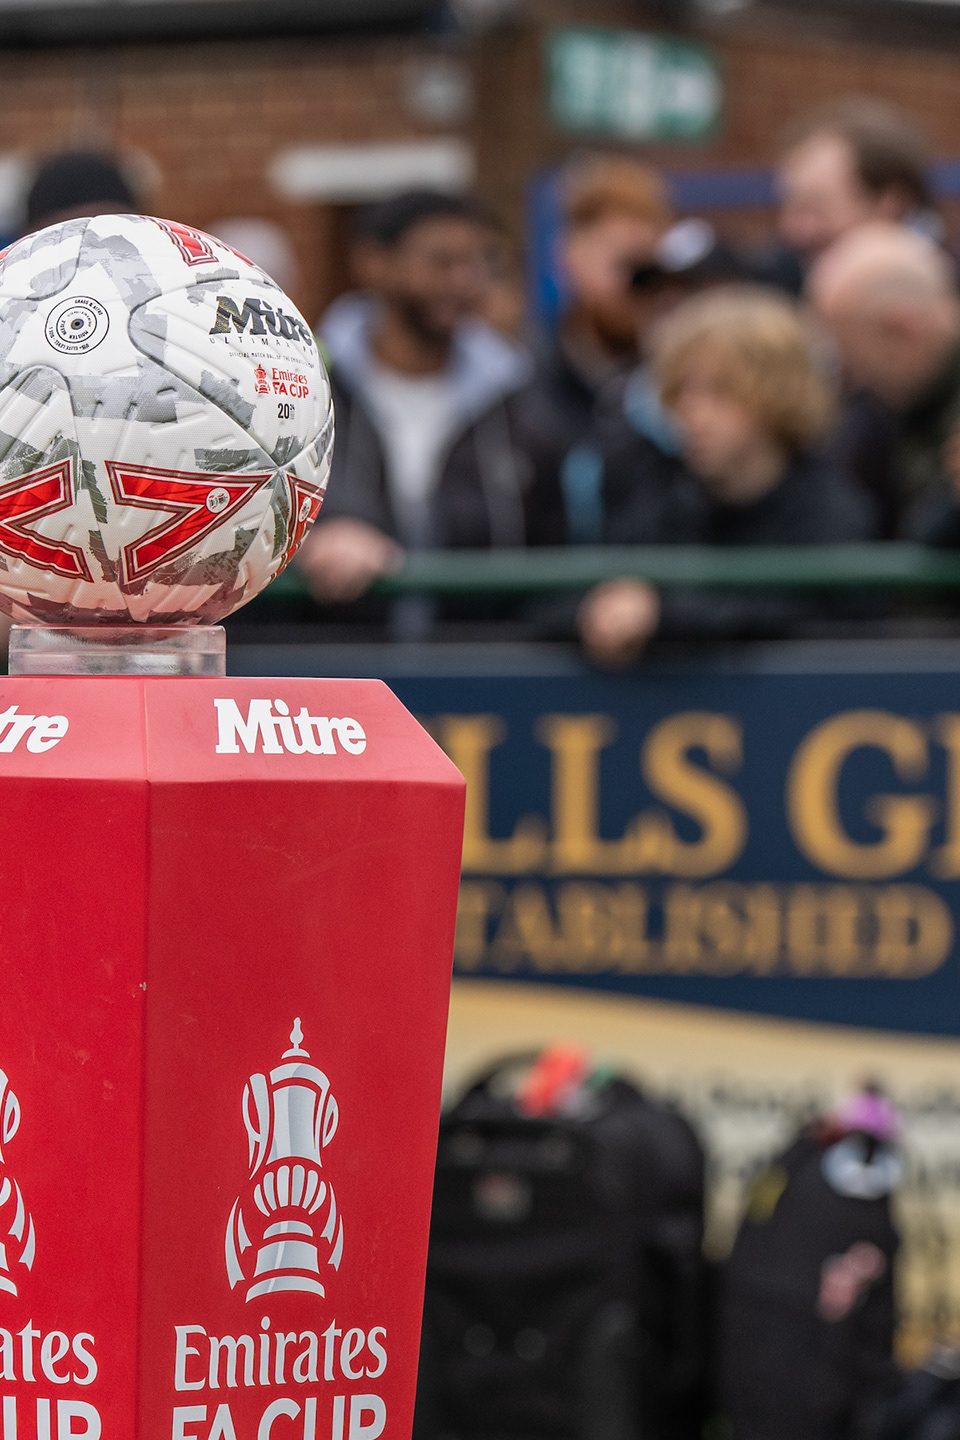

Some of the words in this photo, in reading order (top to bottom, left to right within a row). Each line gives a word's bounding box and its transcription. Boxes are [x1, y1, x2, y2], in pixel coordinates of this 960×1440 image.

[209, 296, 312, 347] Mitre
[272, 367, 308, 385] Emiraes
[272, 382, 288, 397] FA
[289, 383, 309, 399] CUP
[213, 698, 367, 756] Mitre
[428, 710, 745, 878] LLS
[452, 880, 950, 978] TABLISHED
[174, 1316, 388, 1392] Emirates
